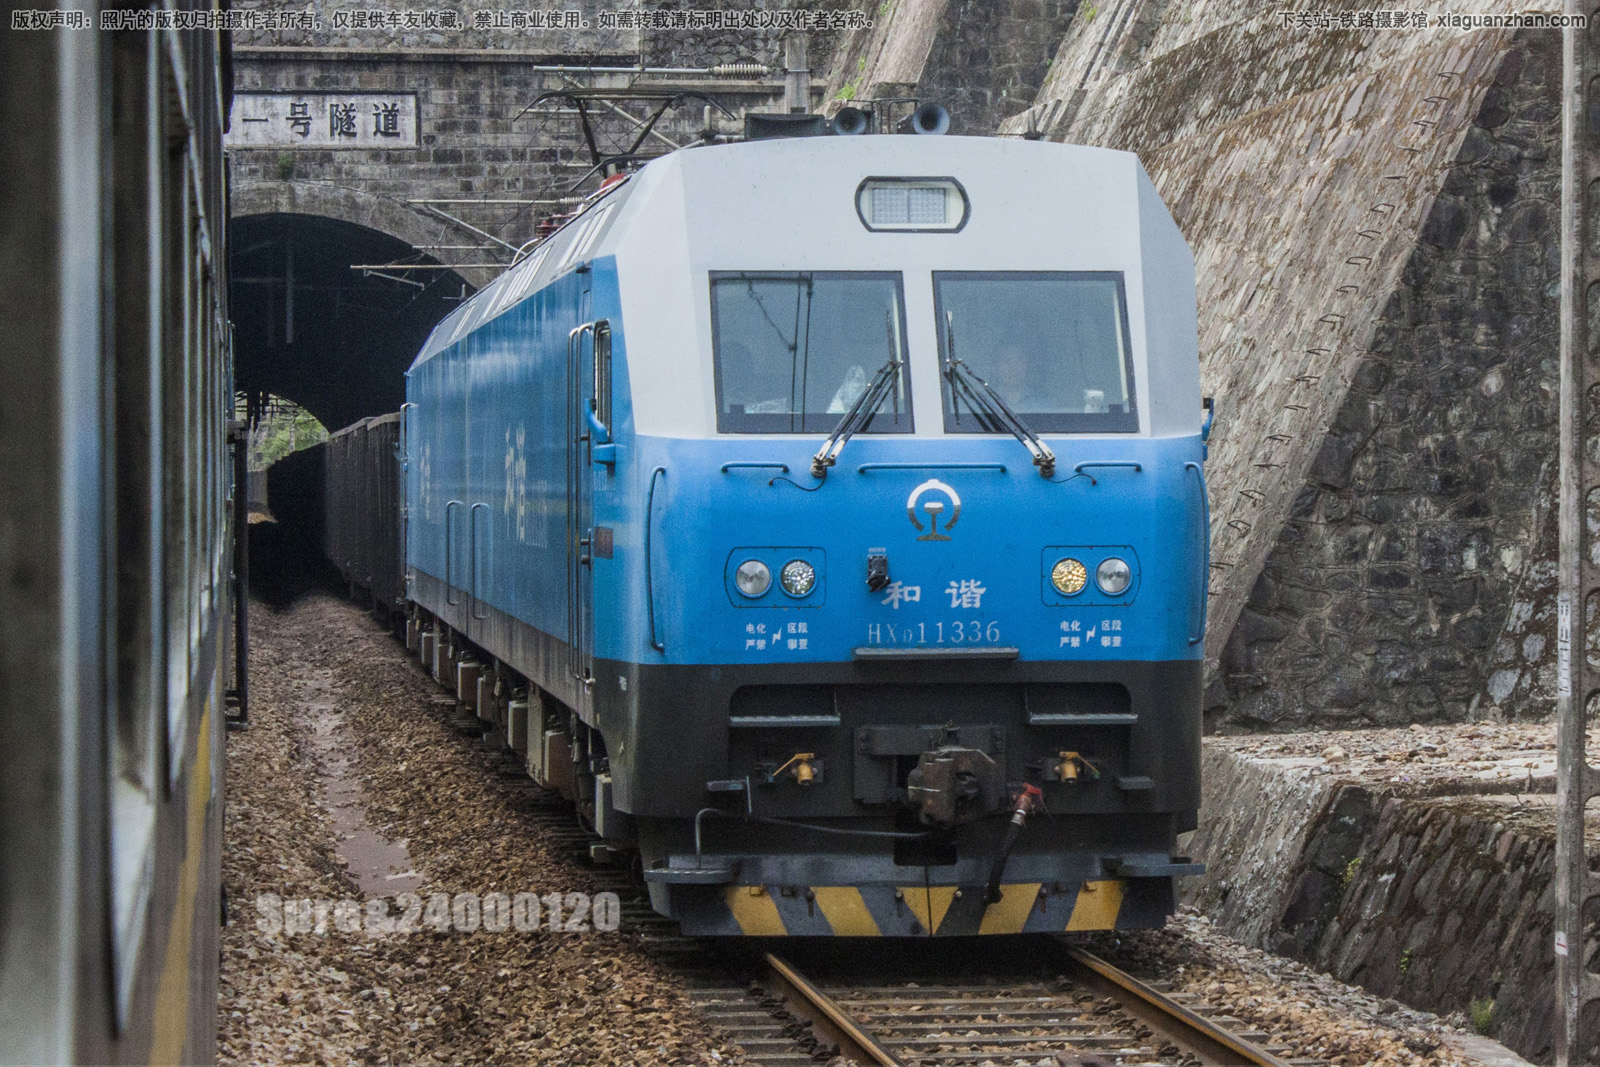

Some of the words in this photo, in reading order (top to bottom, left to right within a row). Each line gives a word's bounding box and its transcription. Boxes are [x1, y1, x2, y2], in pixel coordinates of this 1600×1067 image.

[241, 102, 401, 138] 一号隧道
[881, 578, 987, 610] 和谐
[745, 622, 767, 634] 电化
[787, 622, 809, 634] 区段
[1060, 620, 1081, 632] 电化
[1101, 620, 1122, 631] 区段
